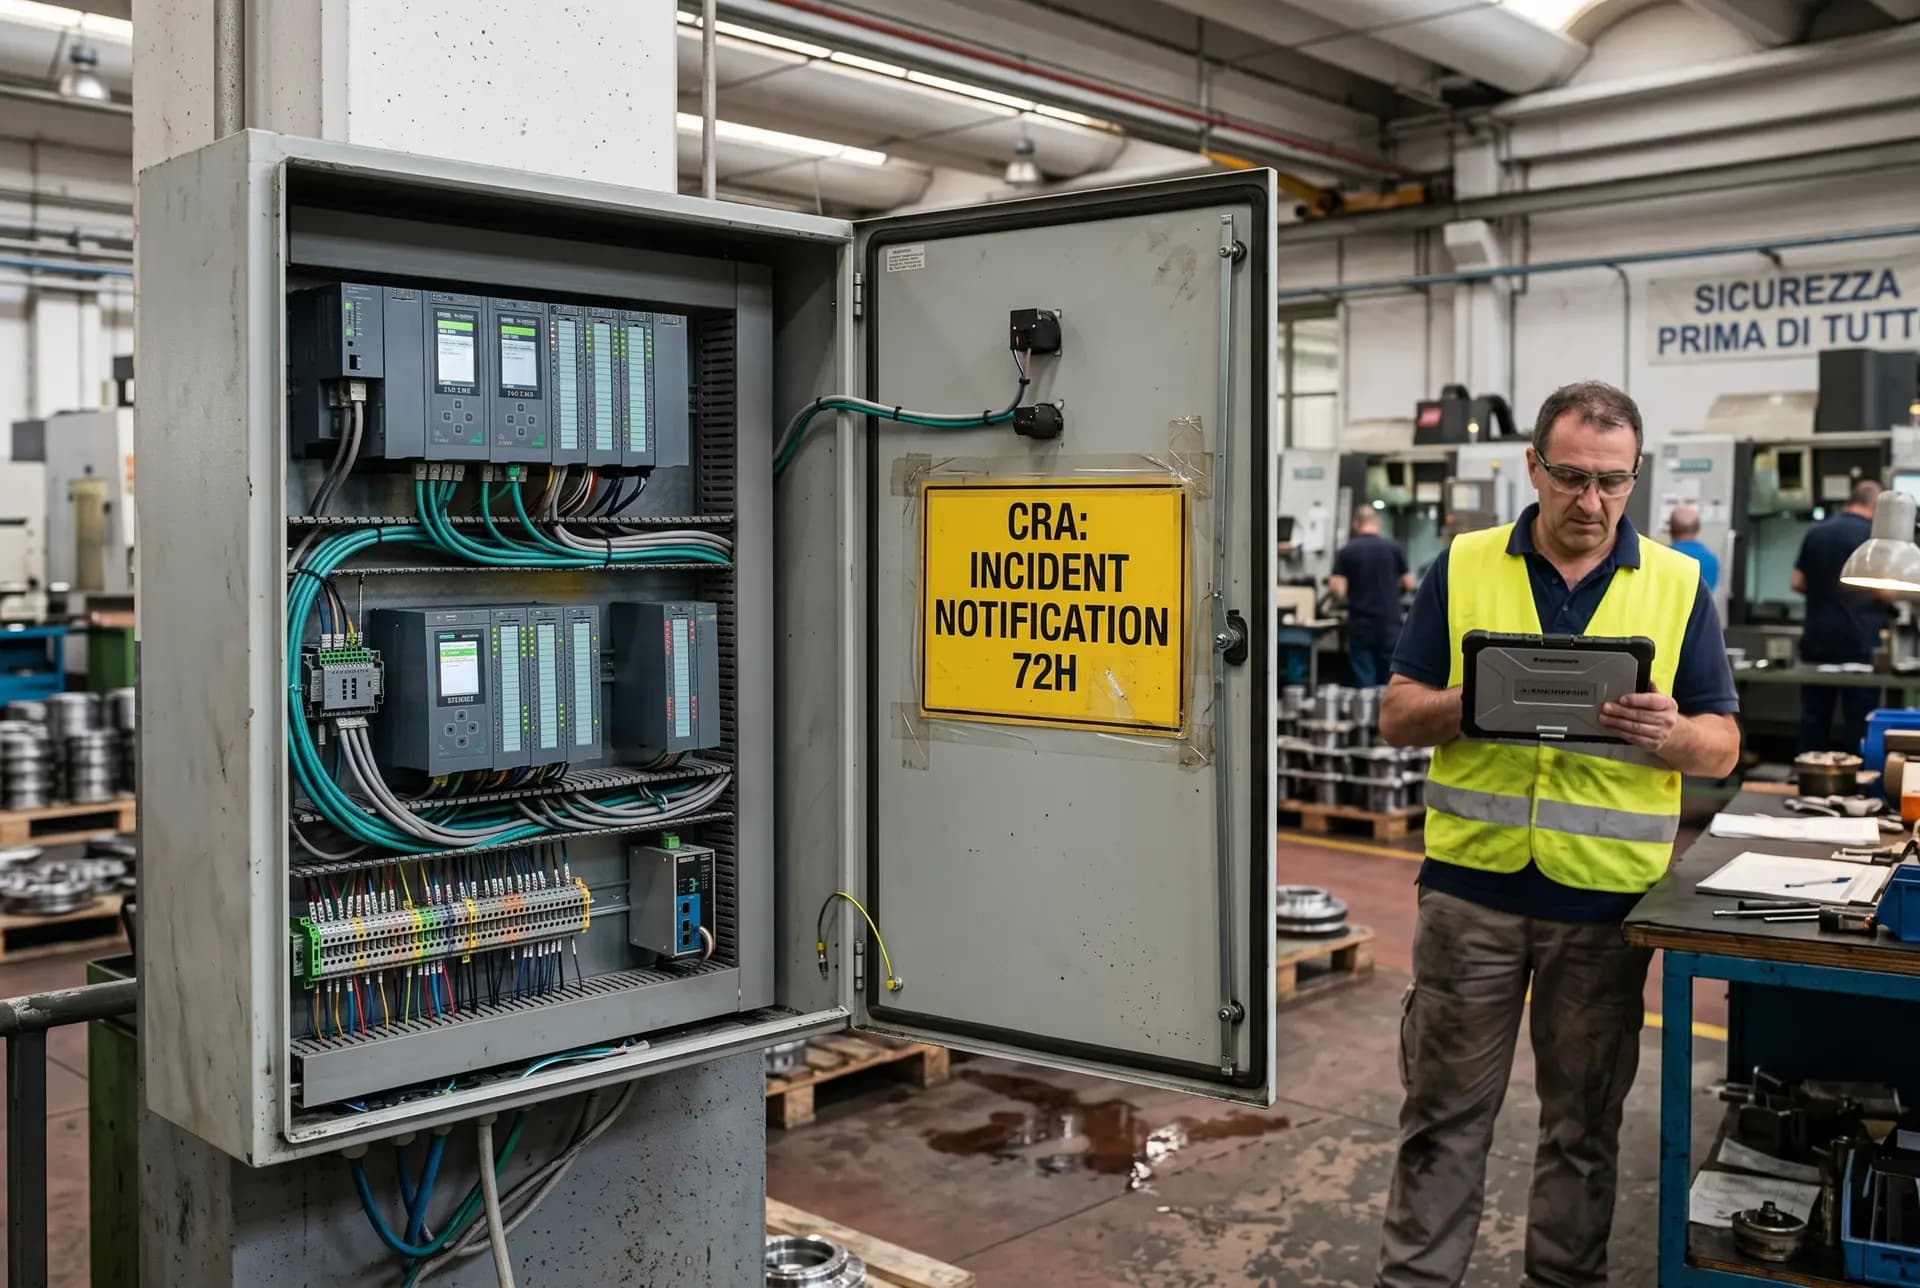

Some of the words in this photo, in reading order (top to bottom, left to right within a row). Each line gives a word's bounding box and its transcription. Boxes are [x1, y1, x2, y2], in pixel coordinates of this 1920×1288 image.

[1694, 267, 1900, 314] SICUREZZA
[1657, 321, 1766, 355] PRIMA
[1776, 317, 1809, 347] DI
[1822, 307, 1920, 343] TUTT
[1008, 502, 1087, 541] CRA:
[970, 551, 1130, 593] INCIDENT
[935, 599, 1168, 647] NOTIFICATION
[1012, 652, 1077, 692] 72H
